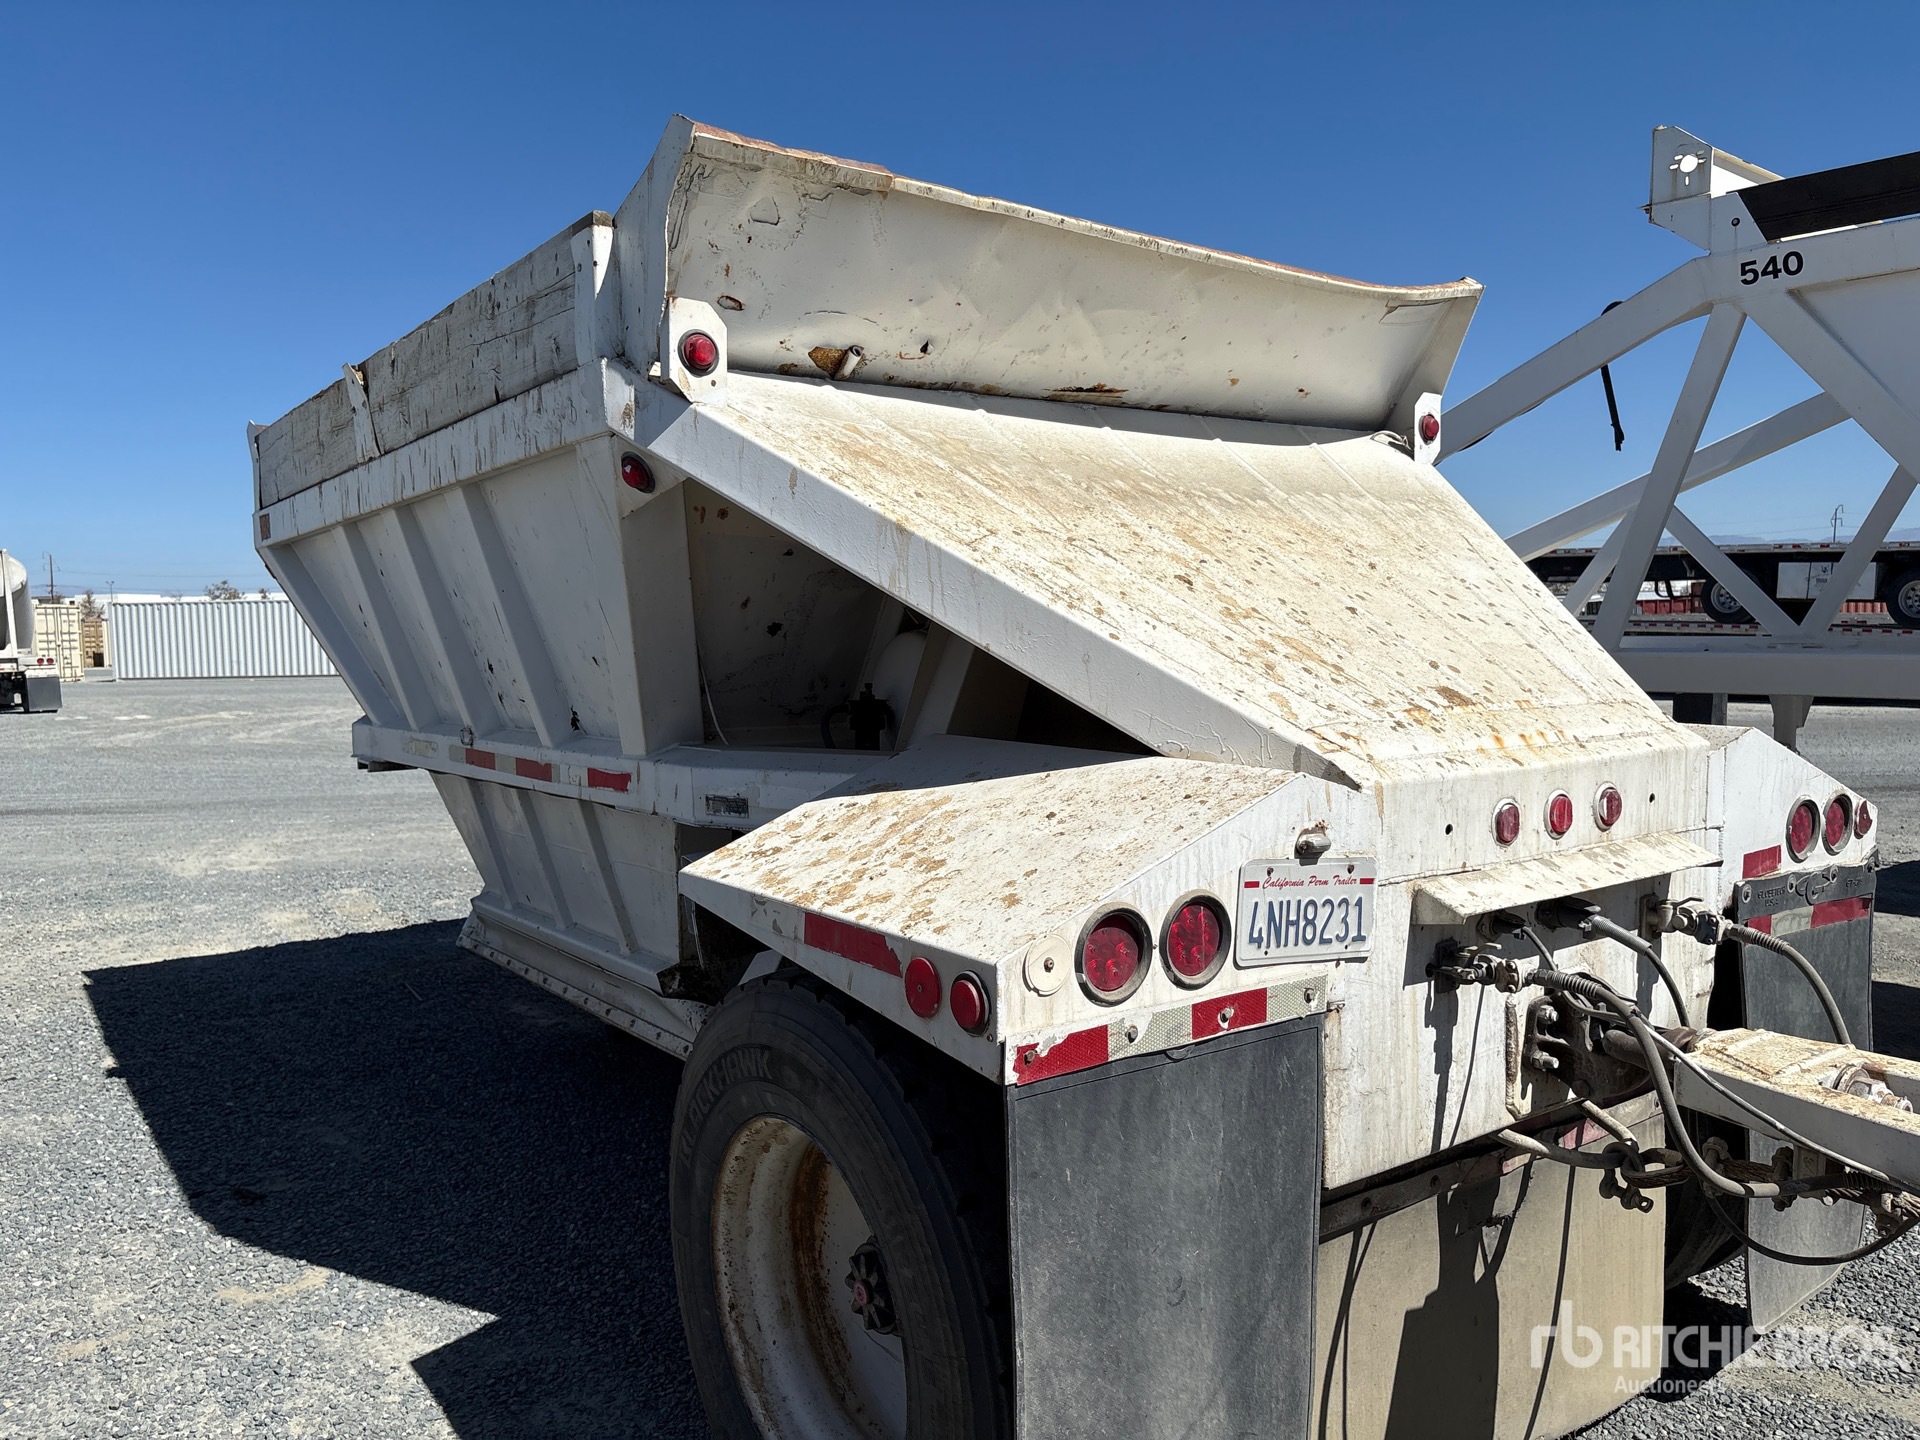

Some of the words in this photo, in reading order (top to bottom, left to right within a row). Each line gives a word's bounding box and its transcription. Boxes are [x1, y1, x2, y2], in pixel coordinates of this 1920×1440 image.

[1740, 251, 1804, 286] 540
[1262, 876, 1305, 890] California
[1307, 875, 1329, 887] Perm
[1333, 874, 1358, 886] Trailer
[1248, 896, 1367, 949] 4NH8231
